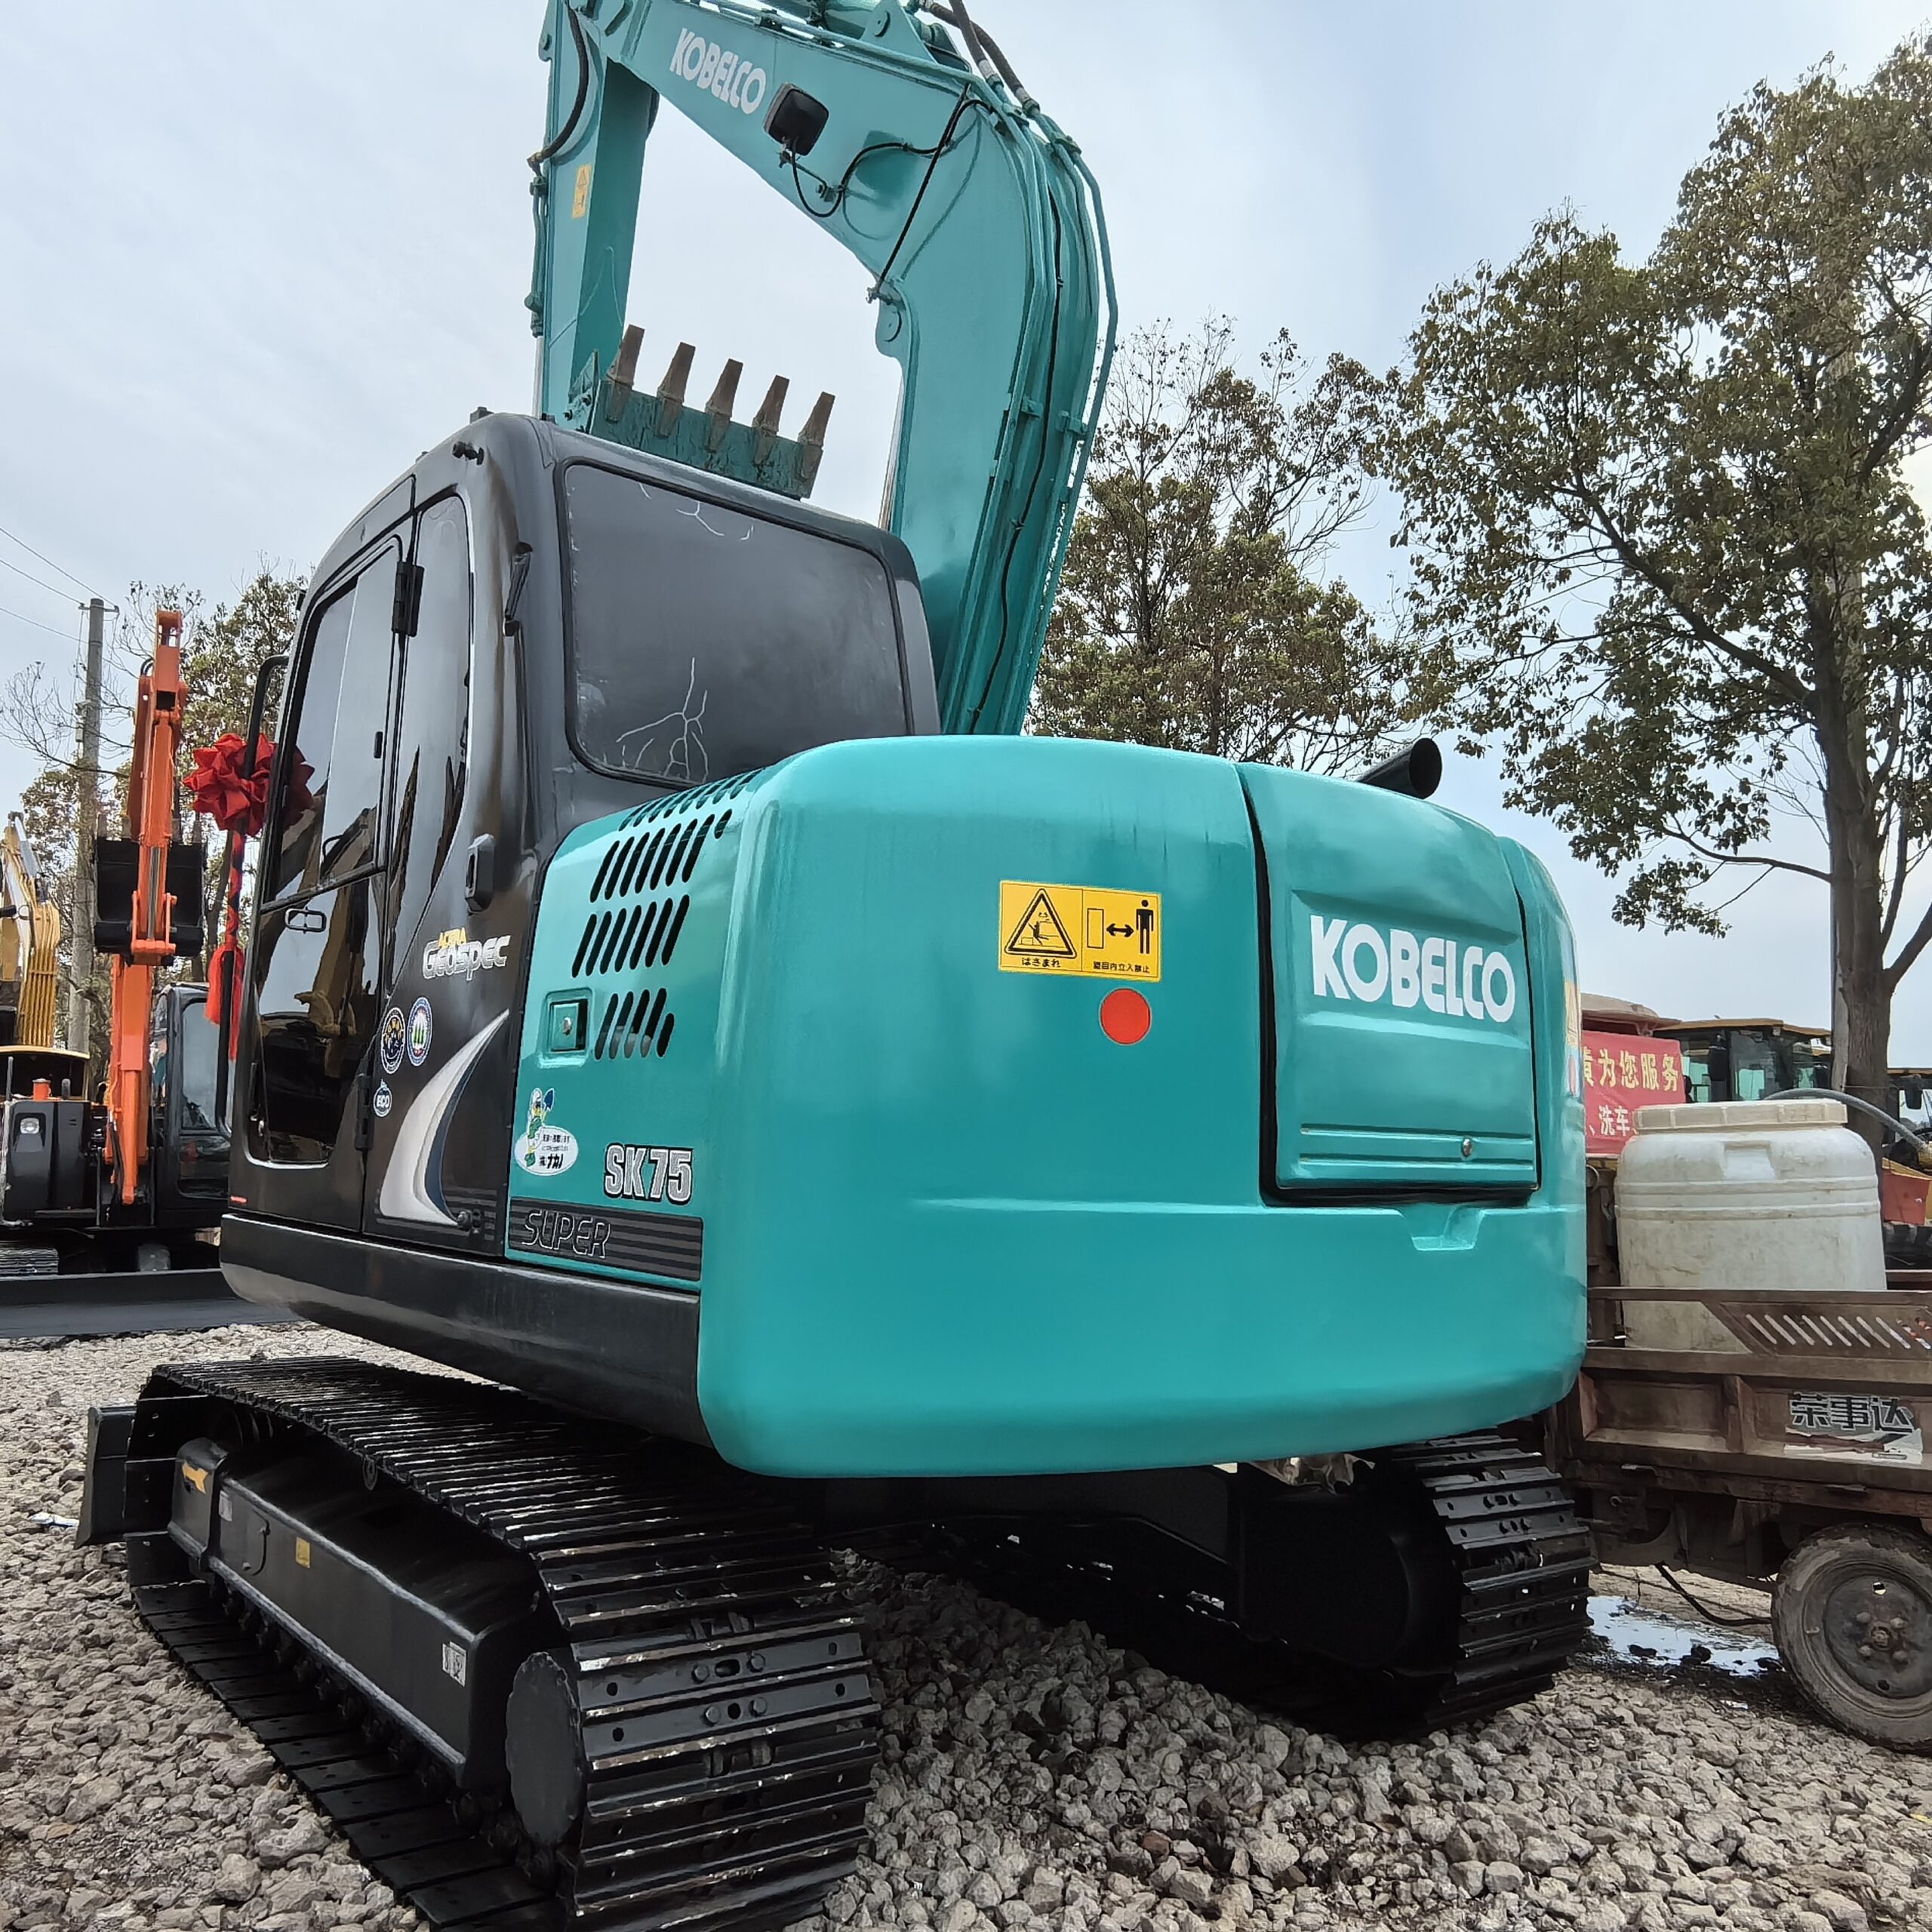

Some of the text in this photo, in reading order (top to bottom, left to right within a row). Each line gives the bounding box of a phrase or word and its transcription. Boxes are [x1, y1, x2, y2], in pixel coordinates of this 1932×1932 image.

[669, 27, 766, 114] KOBELCO
[1021, 957, 1060, 968] はさまれ
[1310, 914, 1515, 1023] KOBELCO
[604, 1143, 694, 1205] SK75
[521, 1209, 611, 1259] SUPER
[1789, 1392, 1915, 1433] 荣事达
